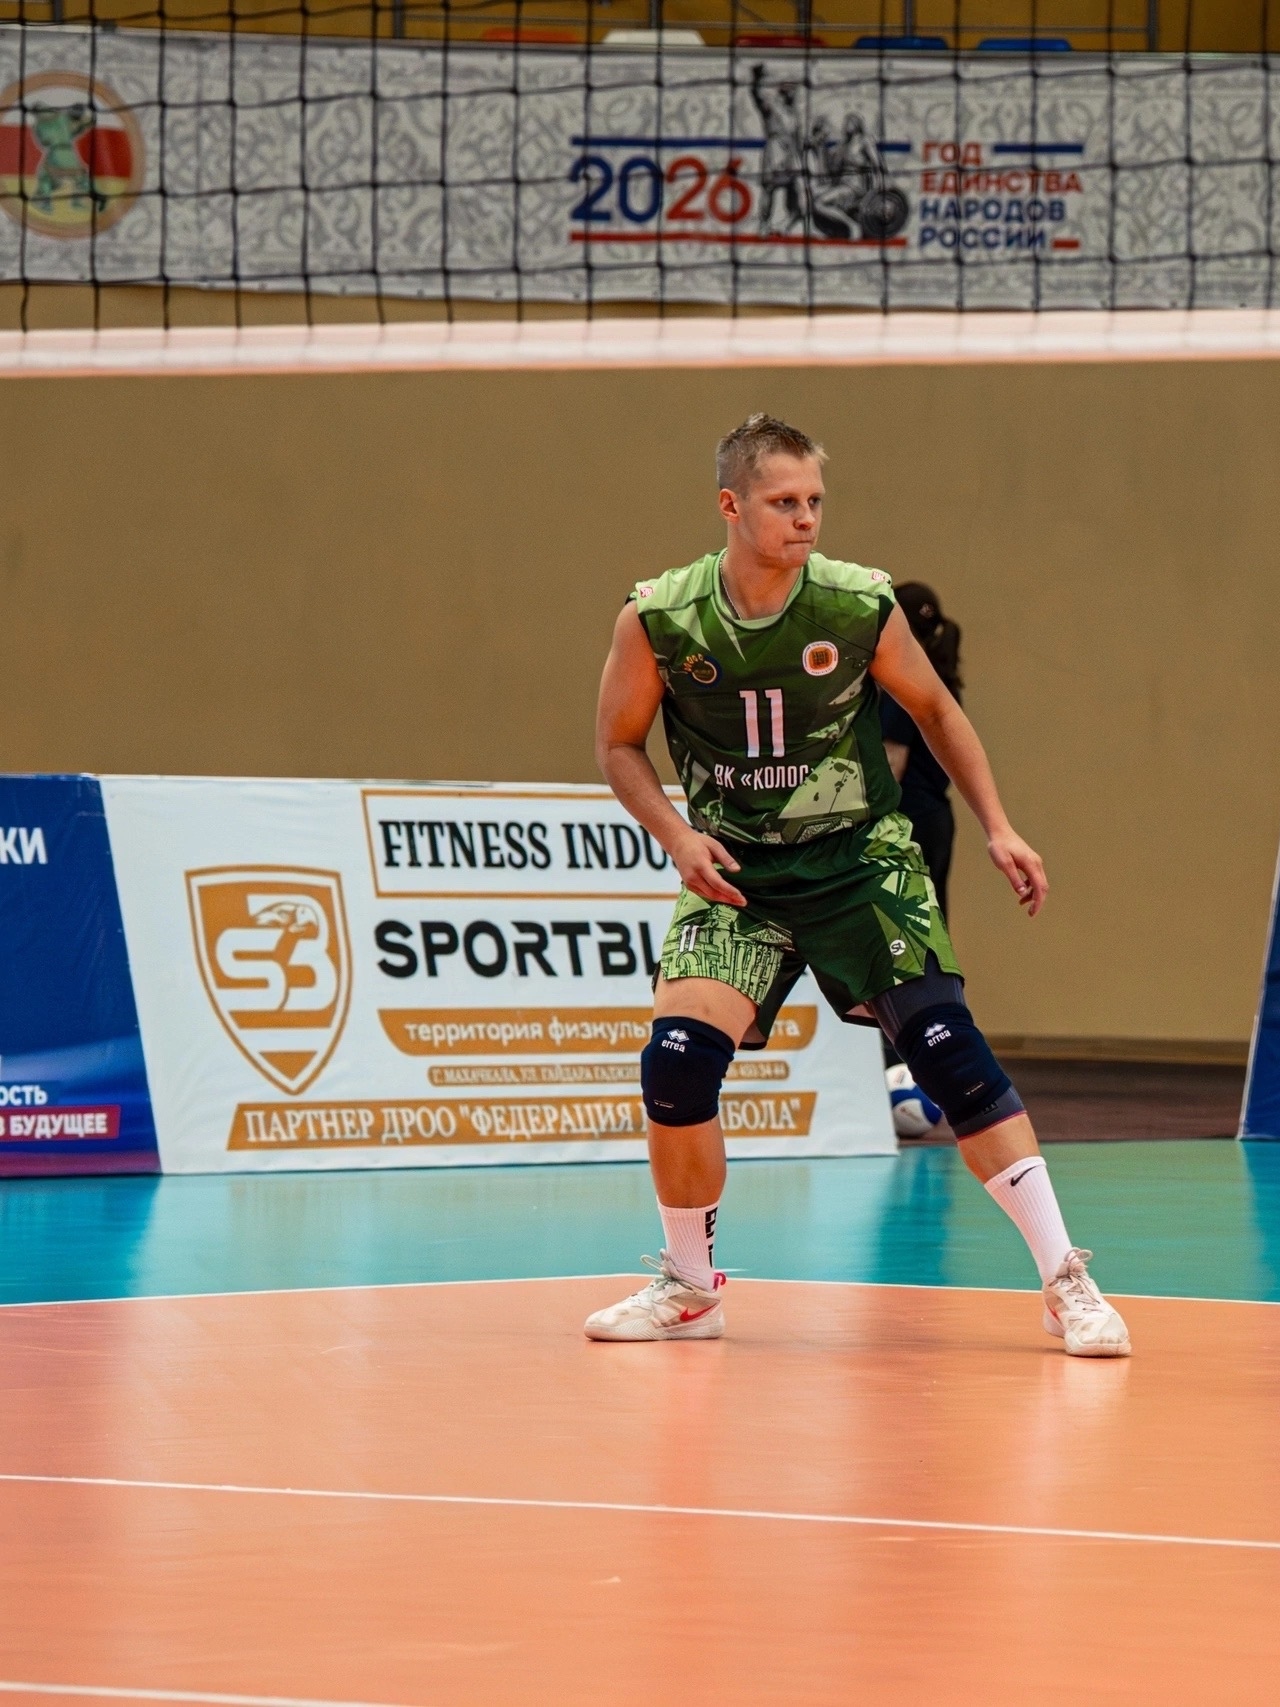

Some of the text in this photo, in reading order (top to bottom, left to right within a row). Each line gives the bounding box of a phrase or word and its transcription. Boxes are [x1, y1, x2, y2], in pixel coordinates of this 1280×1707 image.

[922, 141, 982, 166] ГОД
[570, 156, 753, 223] 2026
[921, 171, 1083, 195] ЕДИНСТВА
[920, 199, 1065, 223] НАРОДОВ
[920, 227, 1046, 248] РОССИИ
[739, 689, 785, 758] 11
[714, 763, 735, 789] ВК
[378, 820, 678, 871] FITNESS INDU
[679, 925, 700, 952] 11
[404, 1022, 543, 1047] территория
[9, 1112, 108, 1139] БУДУЩЕЕ
[244, 1108, 374, 1143] ПАРТНЕР
[381, 1106, 457, 1145] ДРОО
[460, 1100, 633, 1142] "ФЕДЕРАЦИЯ
